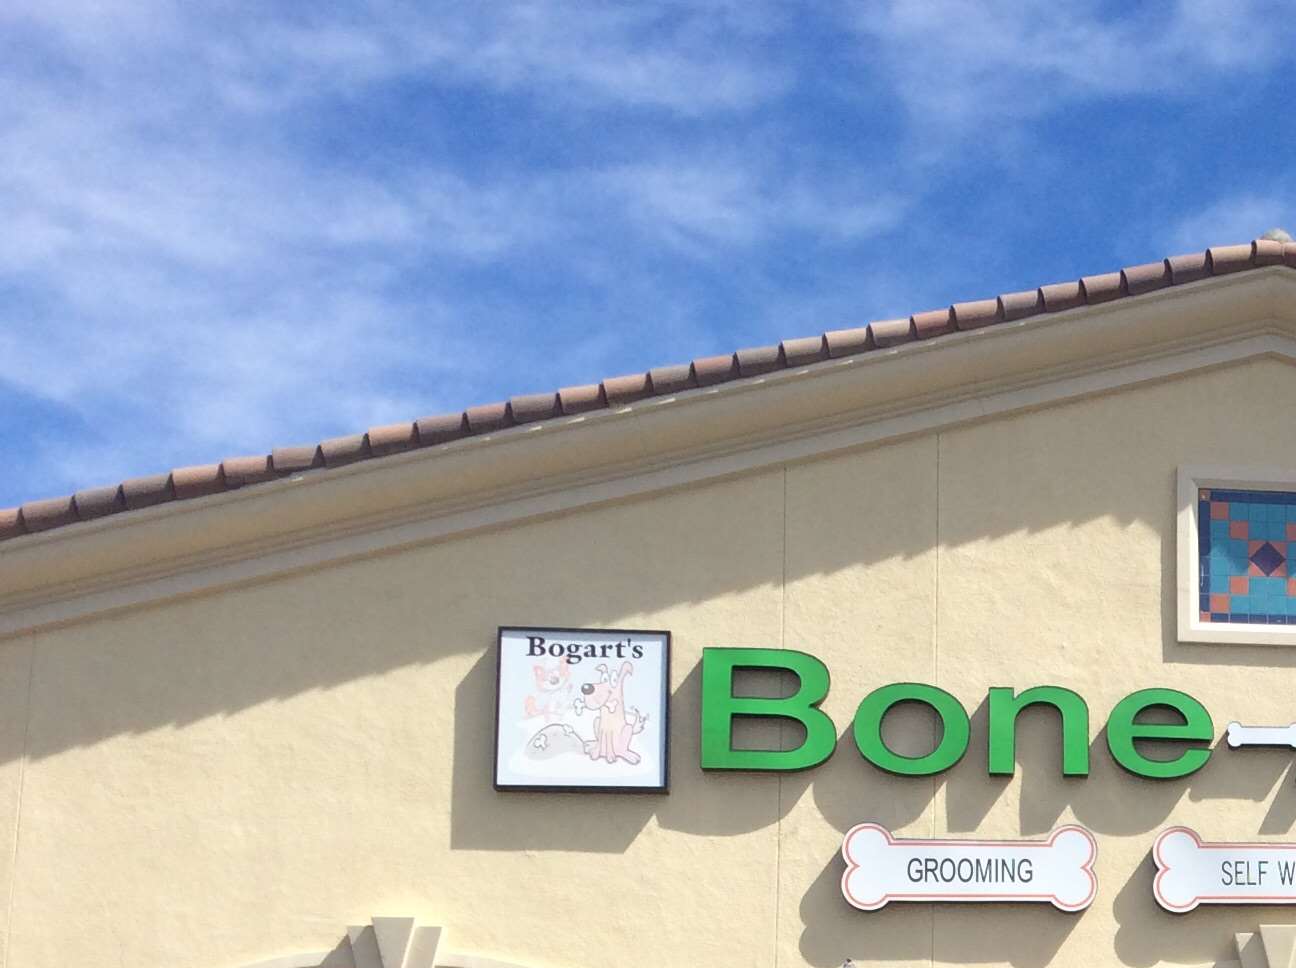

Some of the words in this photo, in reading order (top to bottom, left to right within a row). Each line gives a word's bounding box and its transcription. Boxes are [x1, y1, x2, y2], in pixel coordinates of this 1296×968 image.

[526, 636, 644, 665] Bogart's
[701, 647, 1215, 780] Bone
[907, 857, 1034, 884] GROOMING
[1221, 860, 1269, 887] SELF
